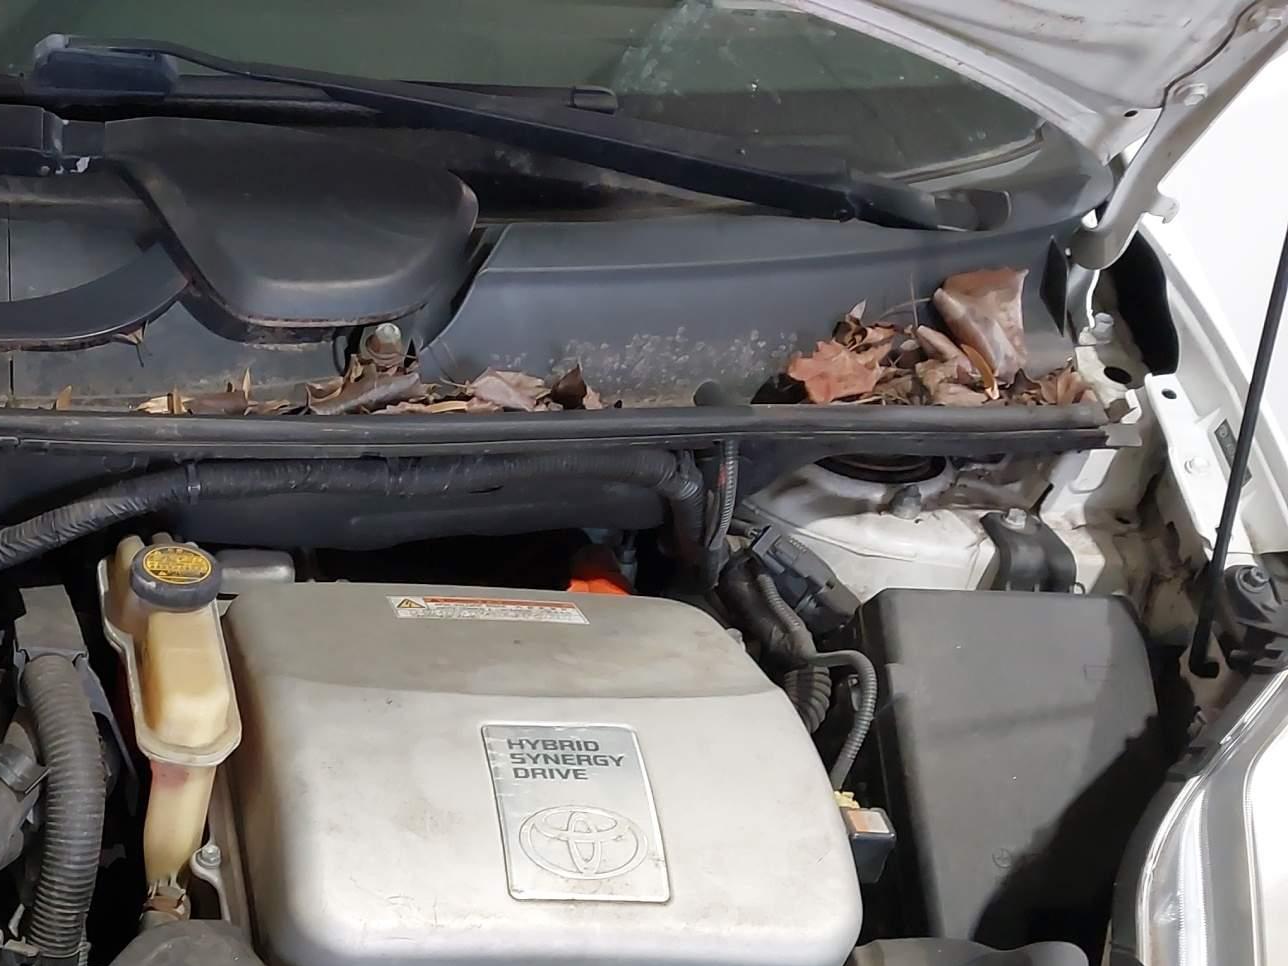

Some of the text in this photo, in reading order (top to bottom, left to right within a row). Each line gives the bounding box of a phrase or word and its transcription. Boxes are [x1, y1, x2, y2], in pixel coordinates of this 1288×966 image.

[507, 739, 600, 752] HYBRID
[510, 753, 625, 767] SYNERGY
[513, 767, 589, 780] DRIVE
